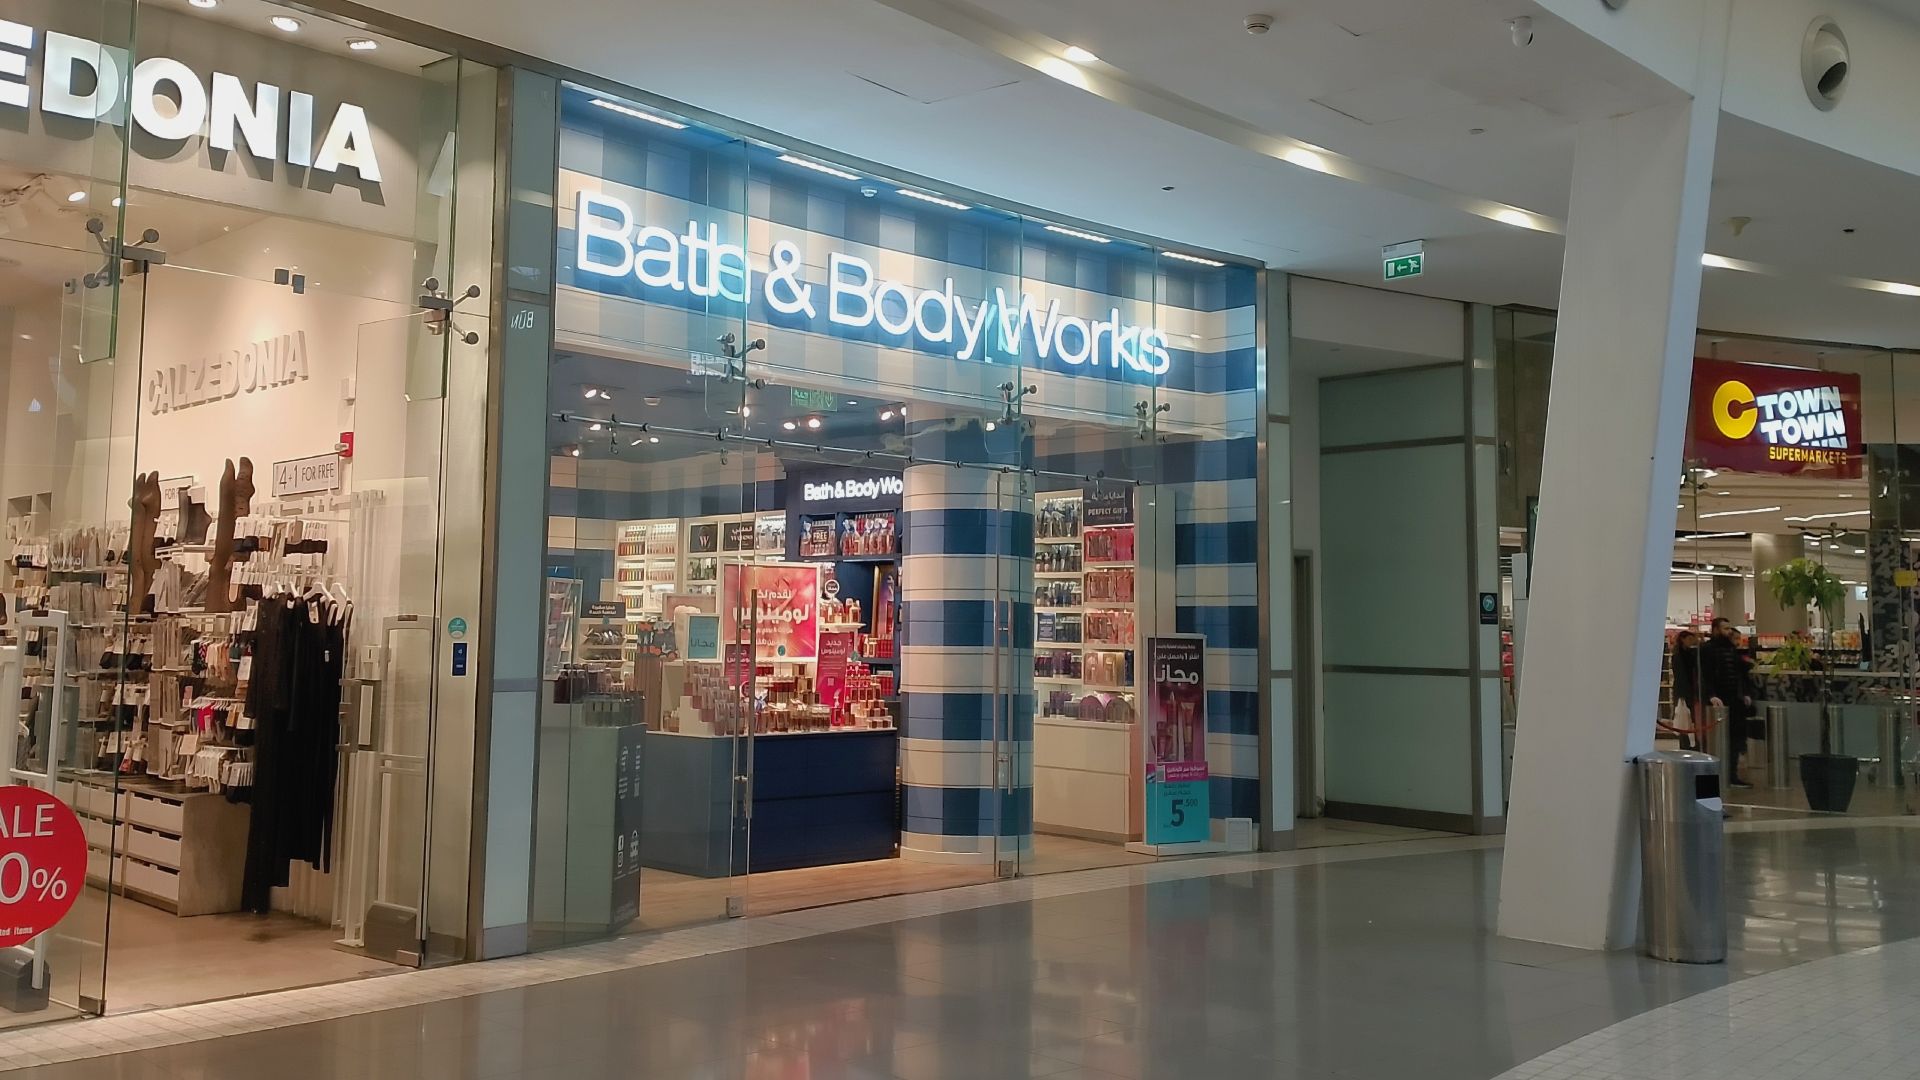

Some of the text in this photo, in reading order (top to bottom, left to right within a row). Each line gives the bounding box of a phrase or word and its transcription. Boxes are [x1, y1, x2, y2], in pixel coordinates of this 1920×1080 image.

[576, 190, 1171, 375] Bath & Body Works
[149, 331, 309, 415] CALZEDONIA
[1756, 386, 1842, 419] TOWN
[1760, 410, 1846, 445] TOWN
[1769, 446, 1847, 464] SUPERMARKETS
[302, 466, 316, 481] FOR
[318, 463, 335, 479] FREE
[165, 488, 176, 500] FOR
[804, 482, 834, 501] Bath
[834, 480, 845, 499] &
[845, 478, 880, 500] Body
[813, 531, 828, 541] FREE
